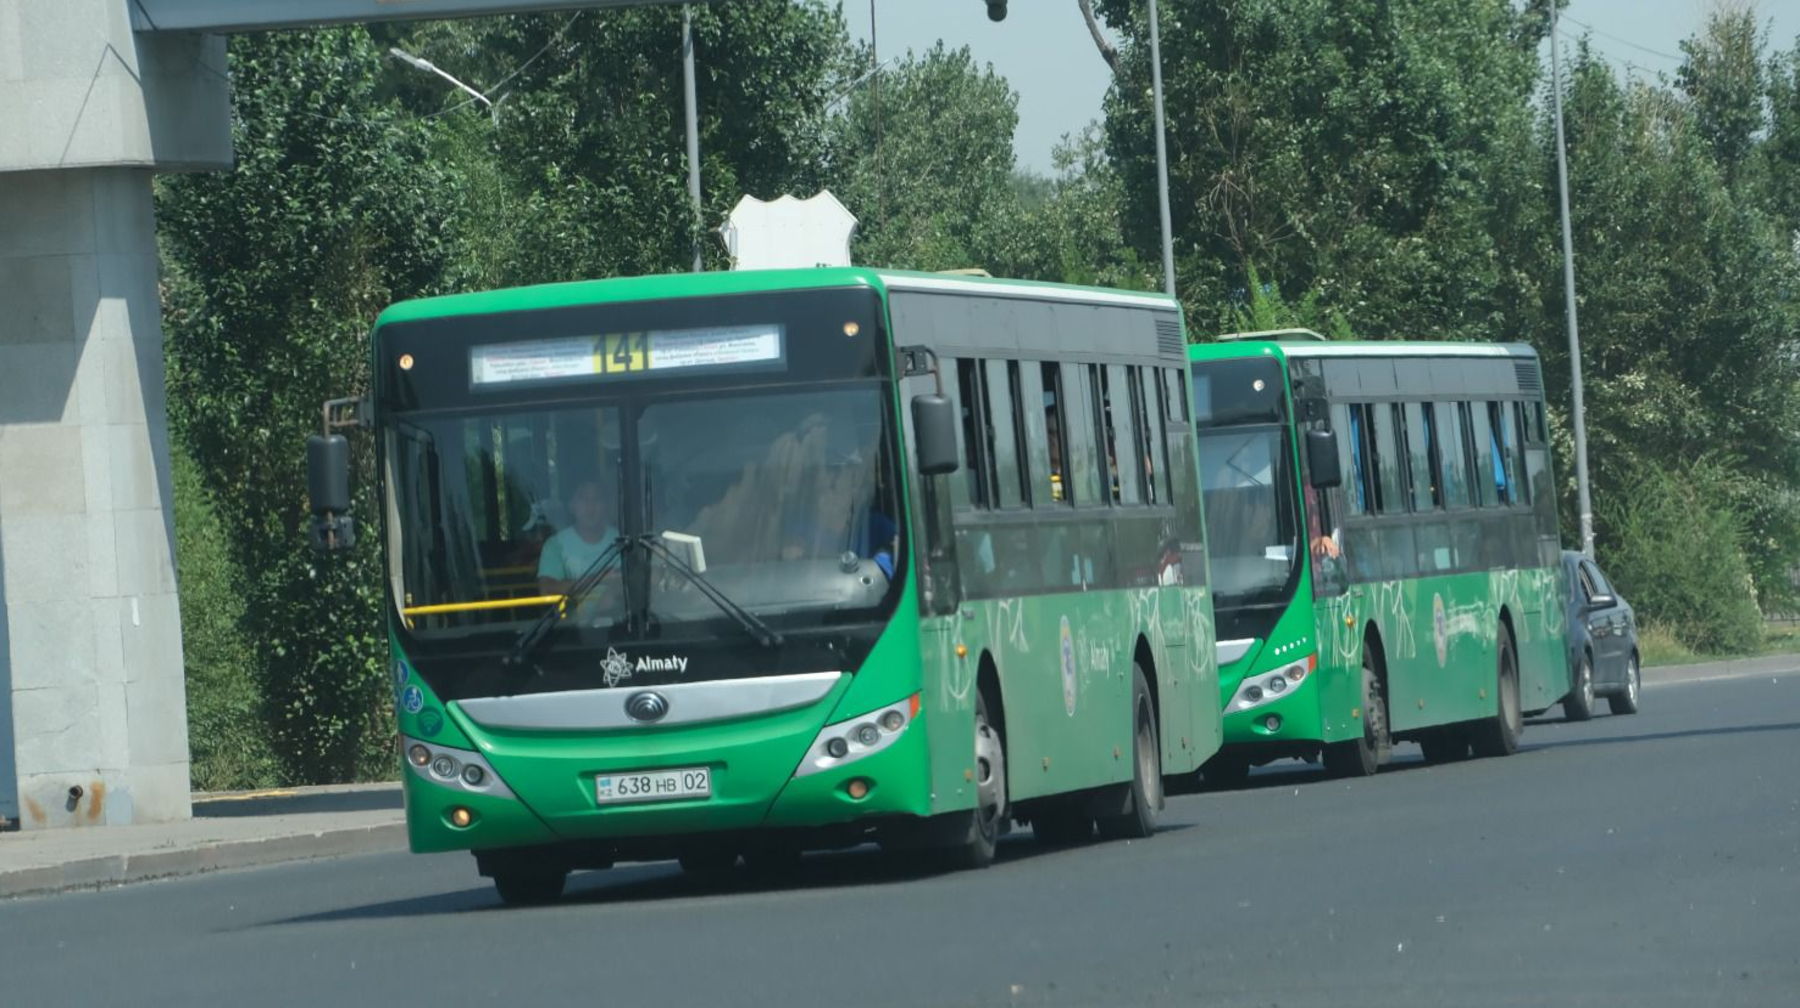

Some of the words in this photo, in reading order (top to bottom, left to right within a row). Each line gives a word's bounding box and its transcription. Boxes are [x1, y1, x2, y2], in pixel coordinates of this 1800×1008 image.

[593, 332, 650, 375] 141
[636, 655, 688, 673] Almaty
[617, 776, 651, 795] 638
[656, 778, 677, 793] HB
[684, 772, 707, 790] 02
